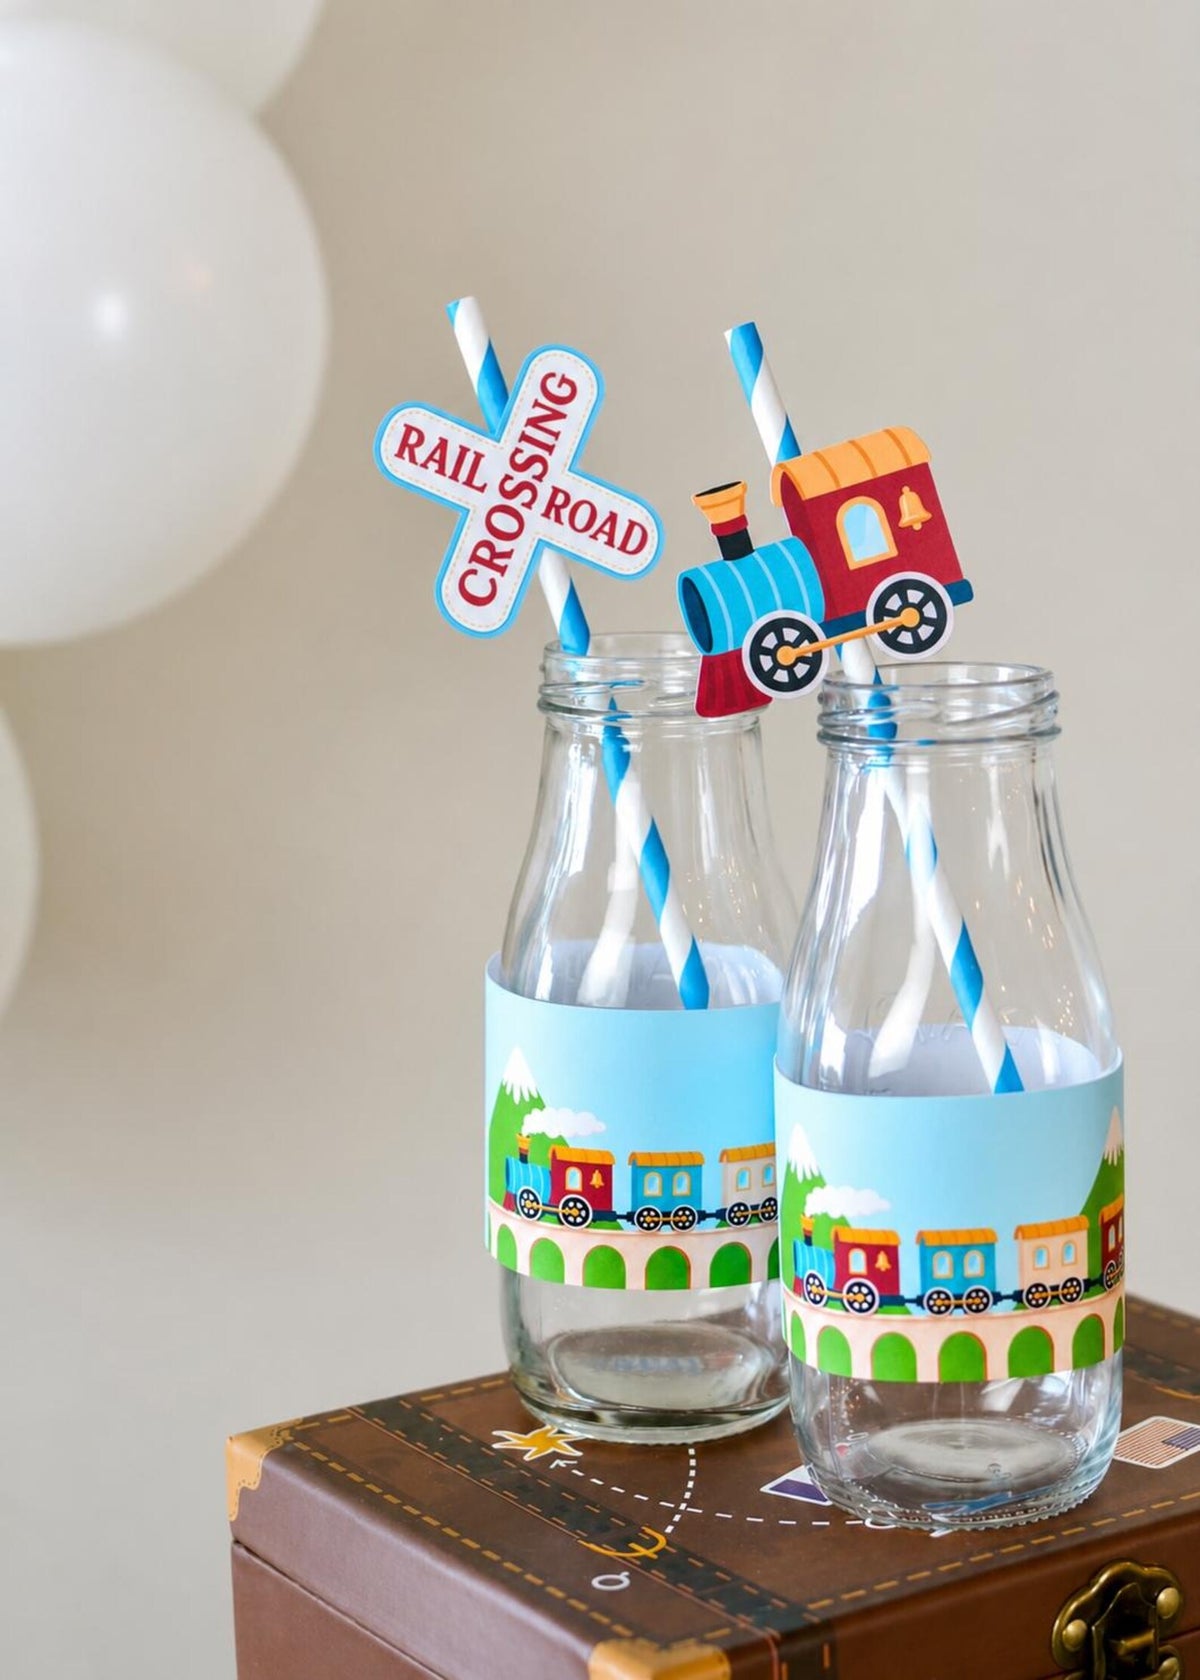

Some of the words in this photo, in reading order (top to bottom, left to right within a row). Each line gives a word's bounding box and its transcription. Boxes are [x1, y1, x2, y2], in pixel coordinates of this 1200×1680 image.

[394, 423, 488, 494] RAIL
[541, 485, 650, 557] ROAD
[457, 371, 578, 608] CROSSING
